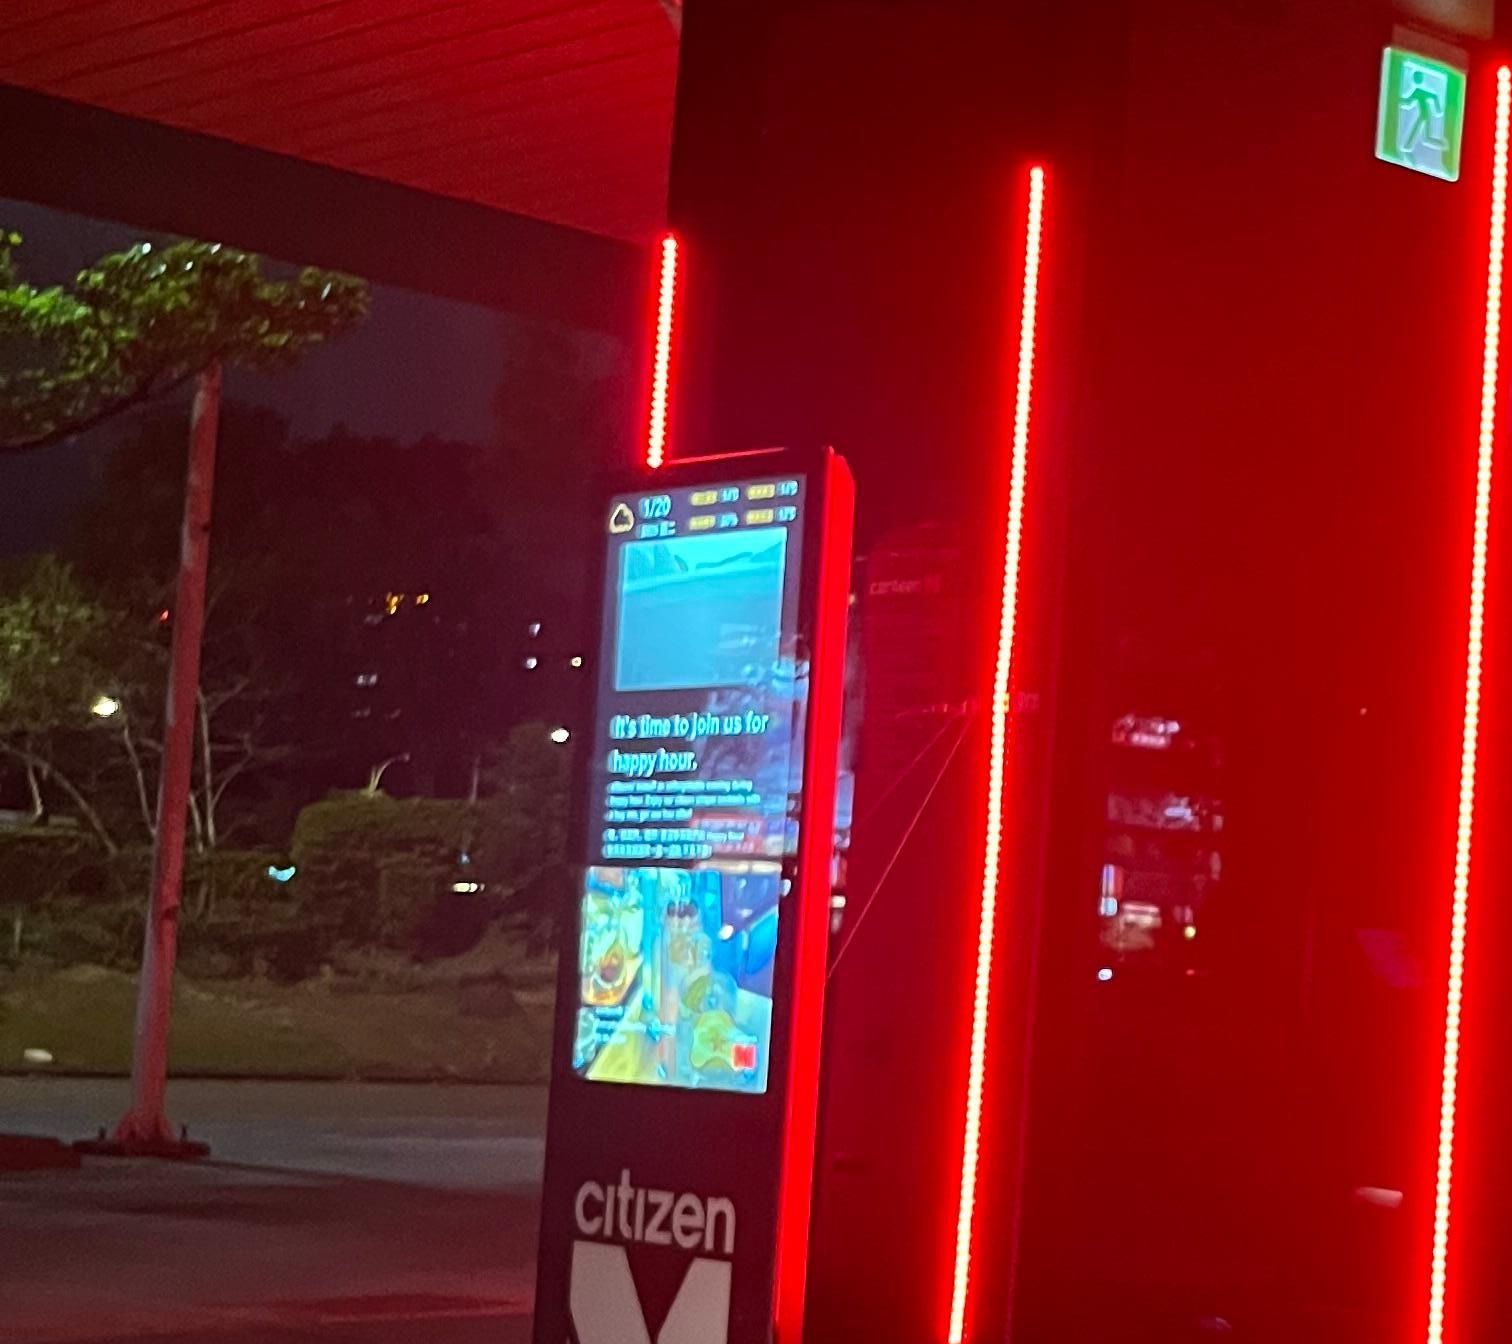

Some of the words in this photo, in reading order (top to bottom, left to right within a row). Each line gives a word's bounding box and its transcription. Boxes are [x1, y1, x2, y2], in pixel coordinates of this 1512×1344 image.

[640, 495, 671, 519] 1/20
[638, 713, 670, 738] time
[672, 713, 689, 737] to
[685, 712, 720, 741] join
[722, 714, 742, 735] us
[744, 710, 769, 734] for
[608, 749, 657, 777] happy
[657, 748, 698, 771] hour.
[574, 1168, 737, 1254] citizen
